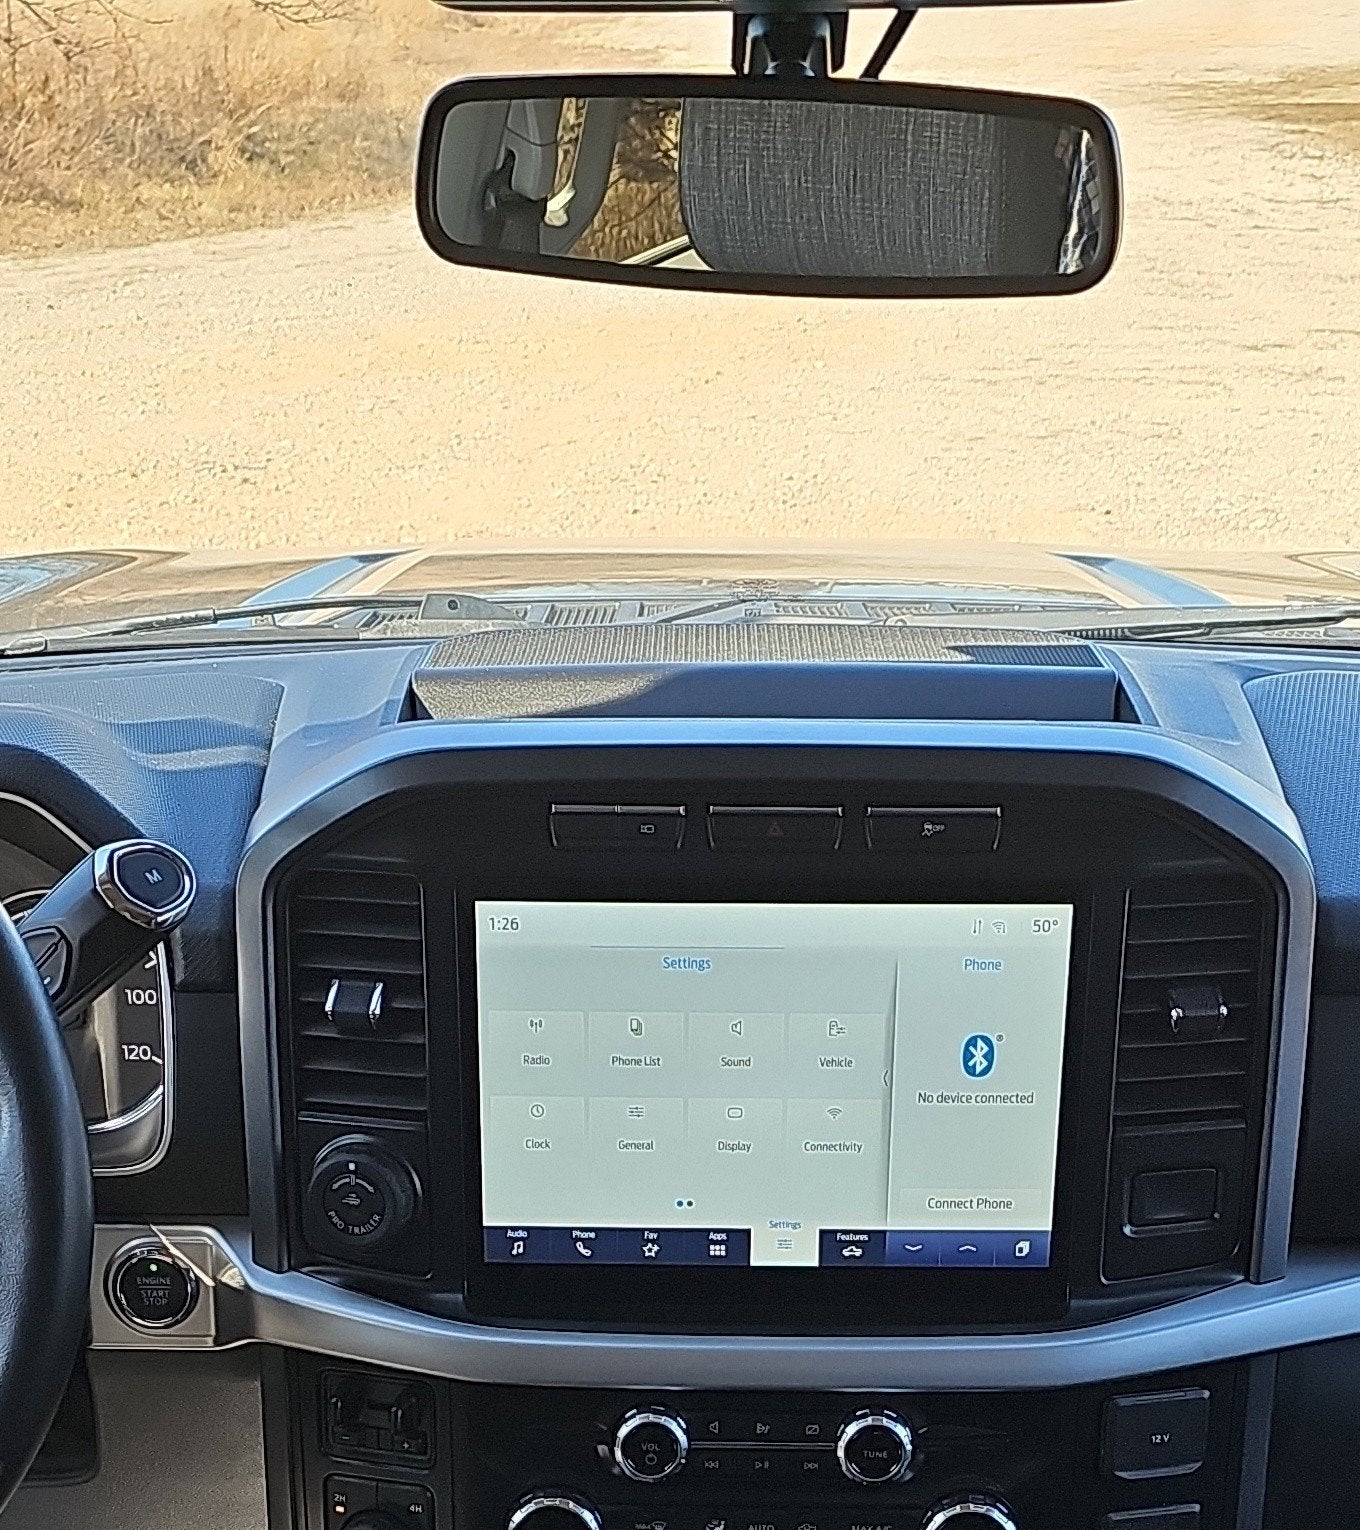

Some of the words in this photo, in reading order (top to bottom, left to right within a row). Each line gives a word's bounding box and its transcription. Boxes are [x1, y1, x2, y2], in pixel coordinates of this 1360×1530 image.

[145, 869, 163, 885] M
[488, 917, 520, 932] 1:26
[662, 956, 712, 971] Settings
[964, 958, 1002, 971] Phone
[125, 989, 157, 1005] 100
[121, 1045, 152, 1060] 120
[522, 1055, 551, 1066] Radio
[611, 1056, 643, 1067] Phone
[644, 1056, 662, 1067] List
[720, 1056, 752, 1068] Sound
[819, 1057, 853, 1068] Vehicle
[918, 1092, 934, 1104] No
[936, 1092, 973, 1104] device
[974, 1092, 1034, 1104] connected
[525, 1139, 551, 1150] Clock
[618, 1140, 654, 1151] General
[718, 1140, 752, 1152] Display
[804, 1142, 863, 1154] Connectivity
[927, 1197, 976, 1210] Connect
[978, 1197, 1013, 1210] Phone
[348, 1214, 382, 1235] TRAILER
[768, 1219, 802, 1231] Settings
[506, 1230, 528, 1239] Audio
[572, 1230, 596, 1240] Phone
[644, 1231, 659, 1240] Fav
[708, 1232, 727, 1242] Apps
[836, 1232, 869, 1242] Features
[136, 1276, 171, 1285] ENGINE
[140, 1290, 170, 1298] START
[144, 1298, 168, 1306] STOP
[1151, 1434, 1162, 1444] 12
[1162, 1432, 1170, 1442] V
[641, 1442, 661, 1452] VOL
[862, 1450, 888, 1459] TUNE
